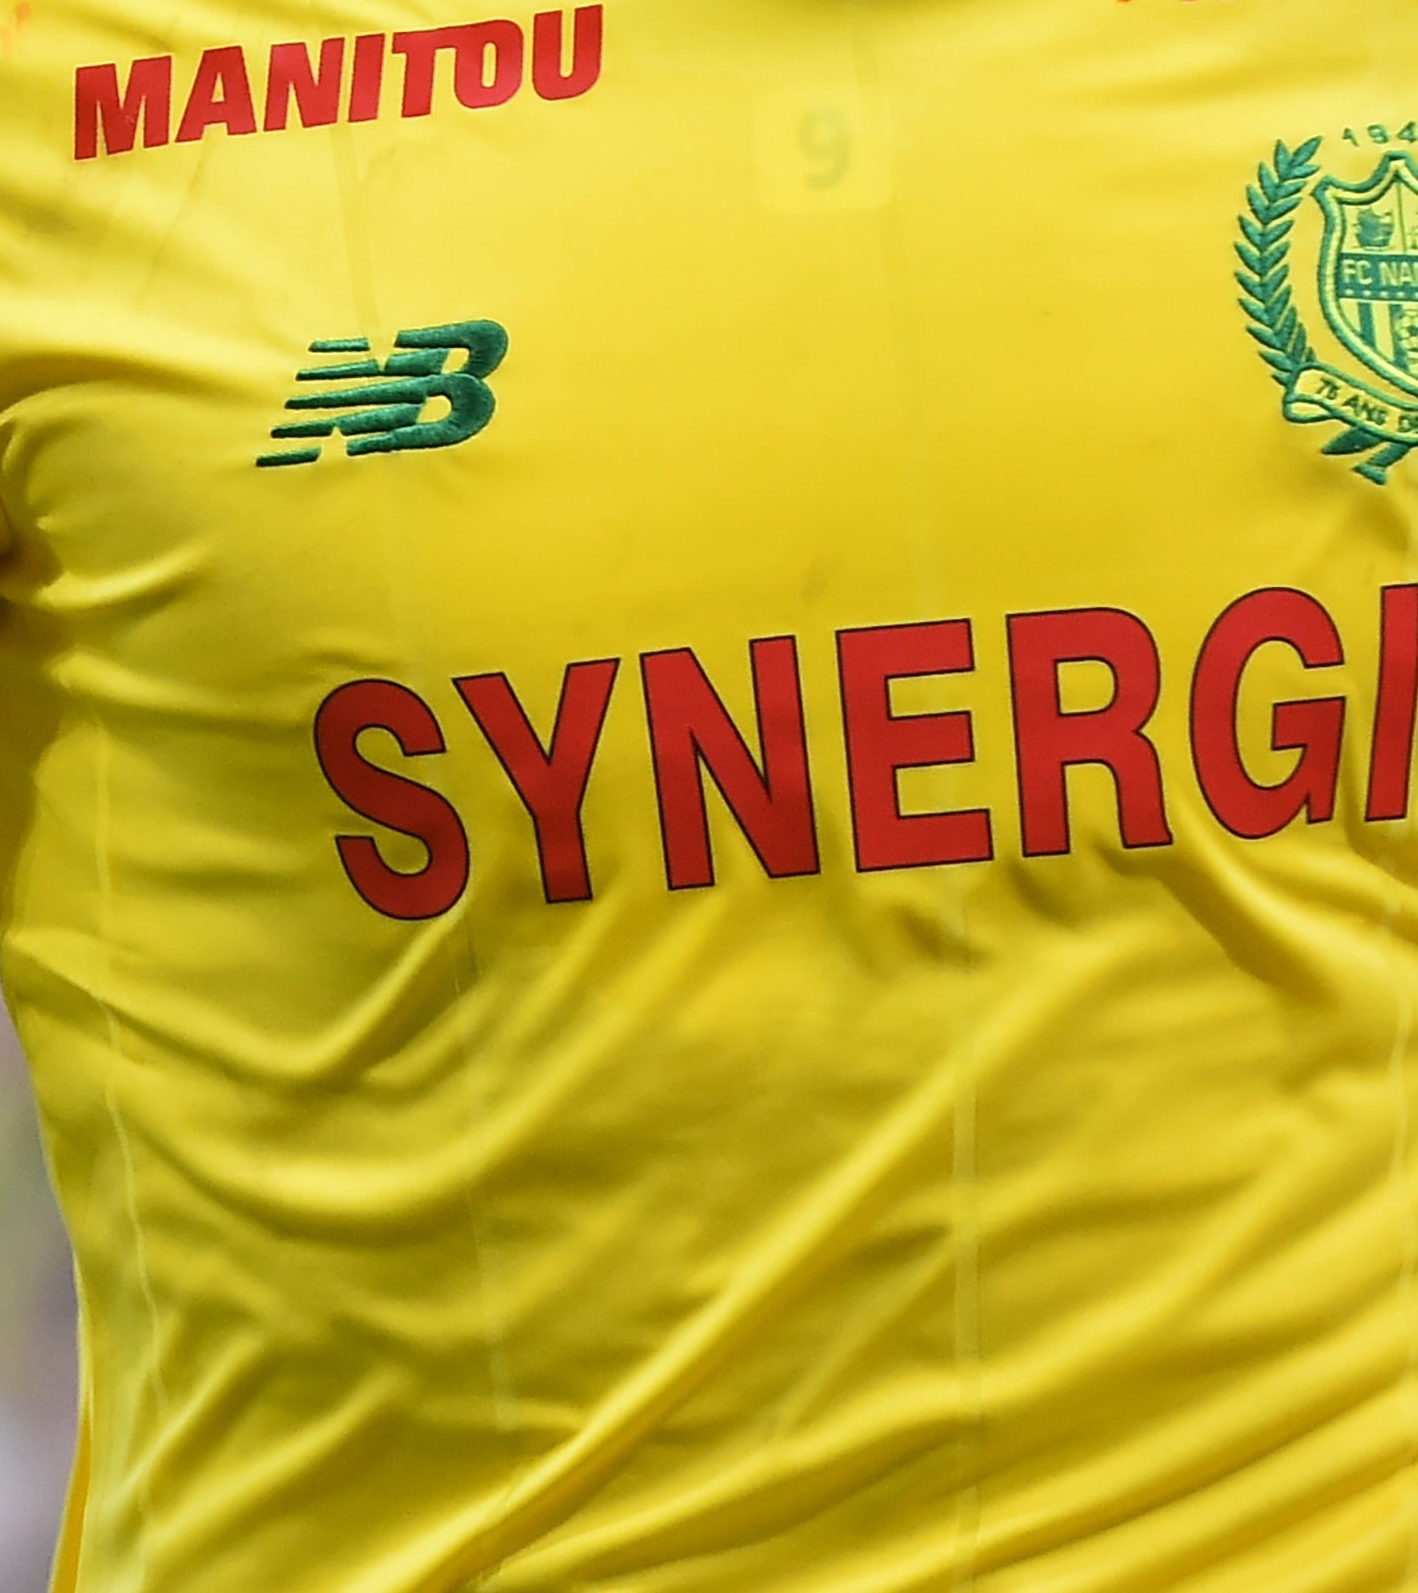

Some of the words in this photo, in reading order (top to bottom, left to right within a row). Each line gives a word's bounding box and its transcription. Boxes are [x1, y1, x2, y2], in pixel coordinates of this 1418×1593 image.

[74, 4, 604, 161] MANITOU
[798, 104, 853, 192] 9
[1341, 259, 1373, 285] FC
